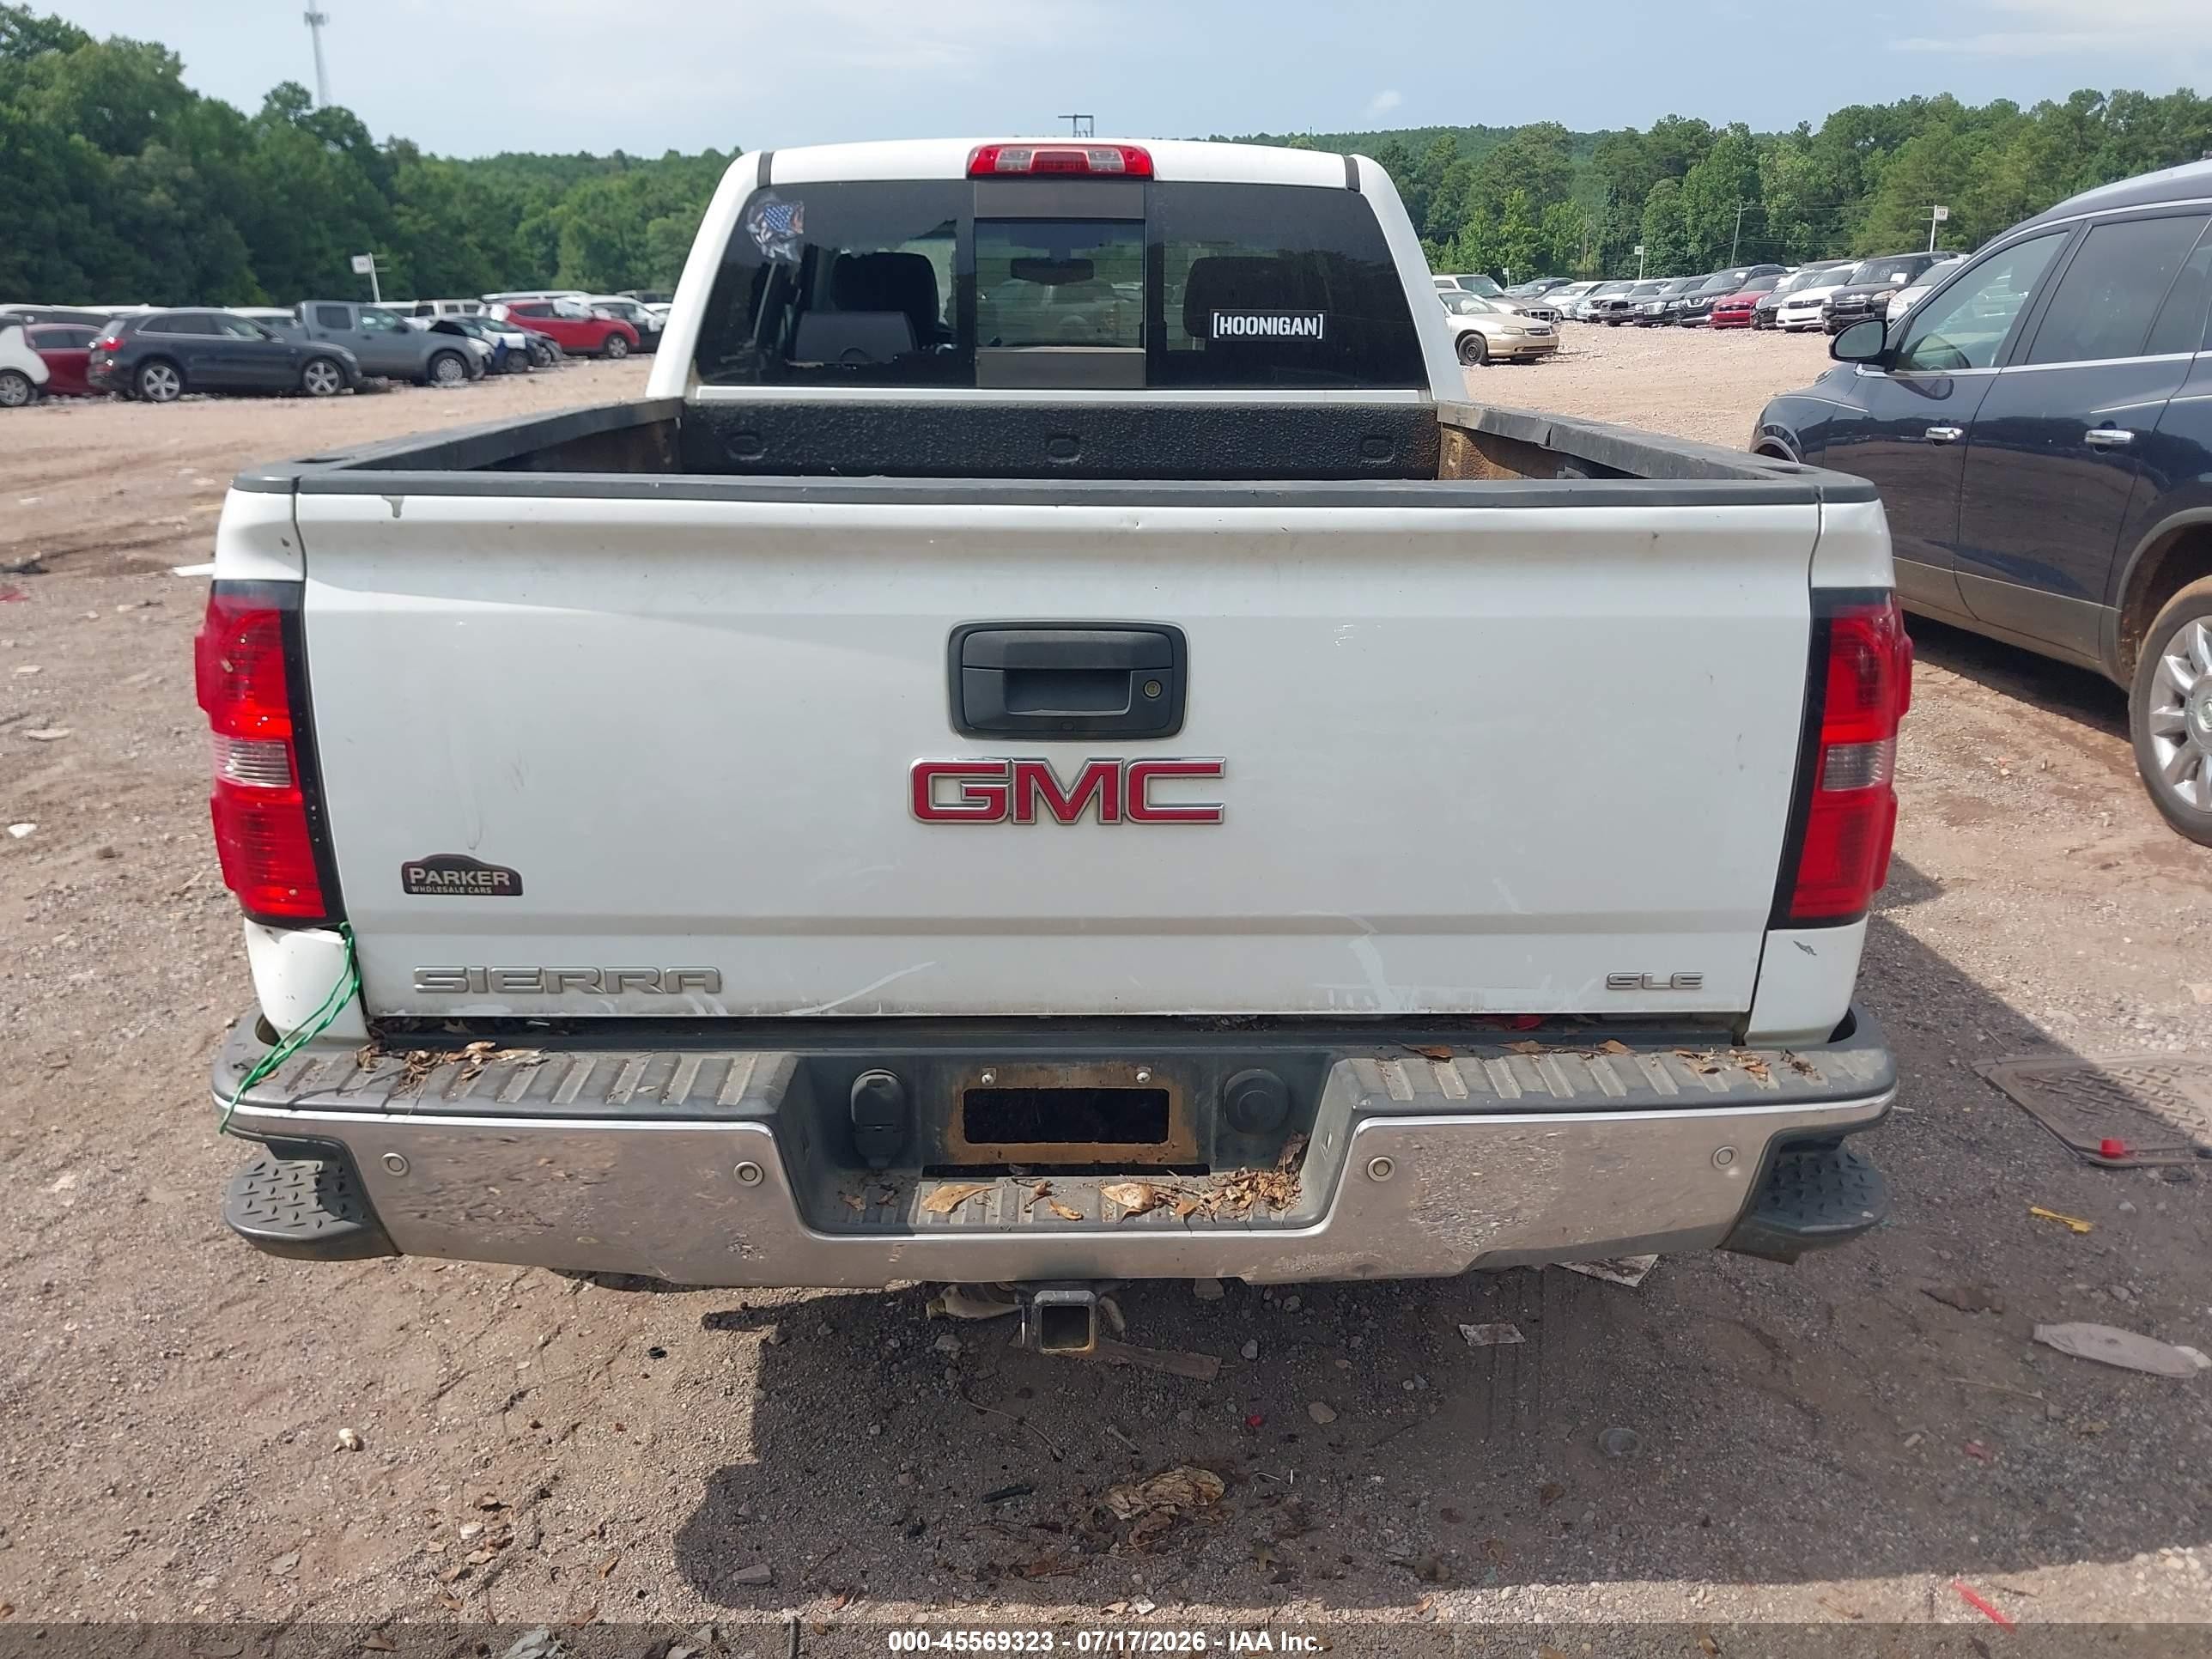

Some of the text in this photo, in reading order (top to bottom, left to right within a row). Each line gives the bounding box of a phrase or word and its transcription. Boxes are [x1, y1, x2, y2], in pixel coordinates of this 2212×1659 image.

[908, 757, 1227, 825] GMC
[409, 866, 510, 886] PARKER
[411, 885, 464, 894] WHOLESALE
[413, 965, 722, 994] SIERRA
[1606, 972, 1704, 990] SLE
